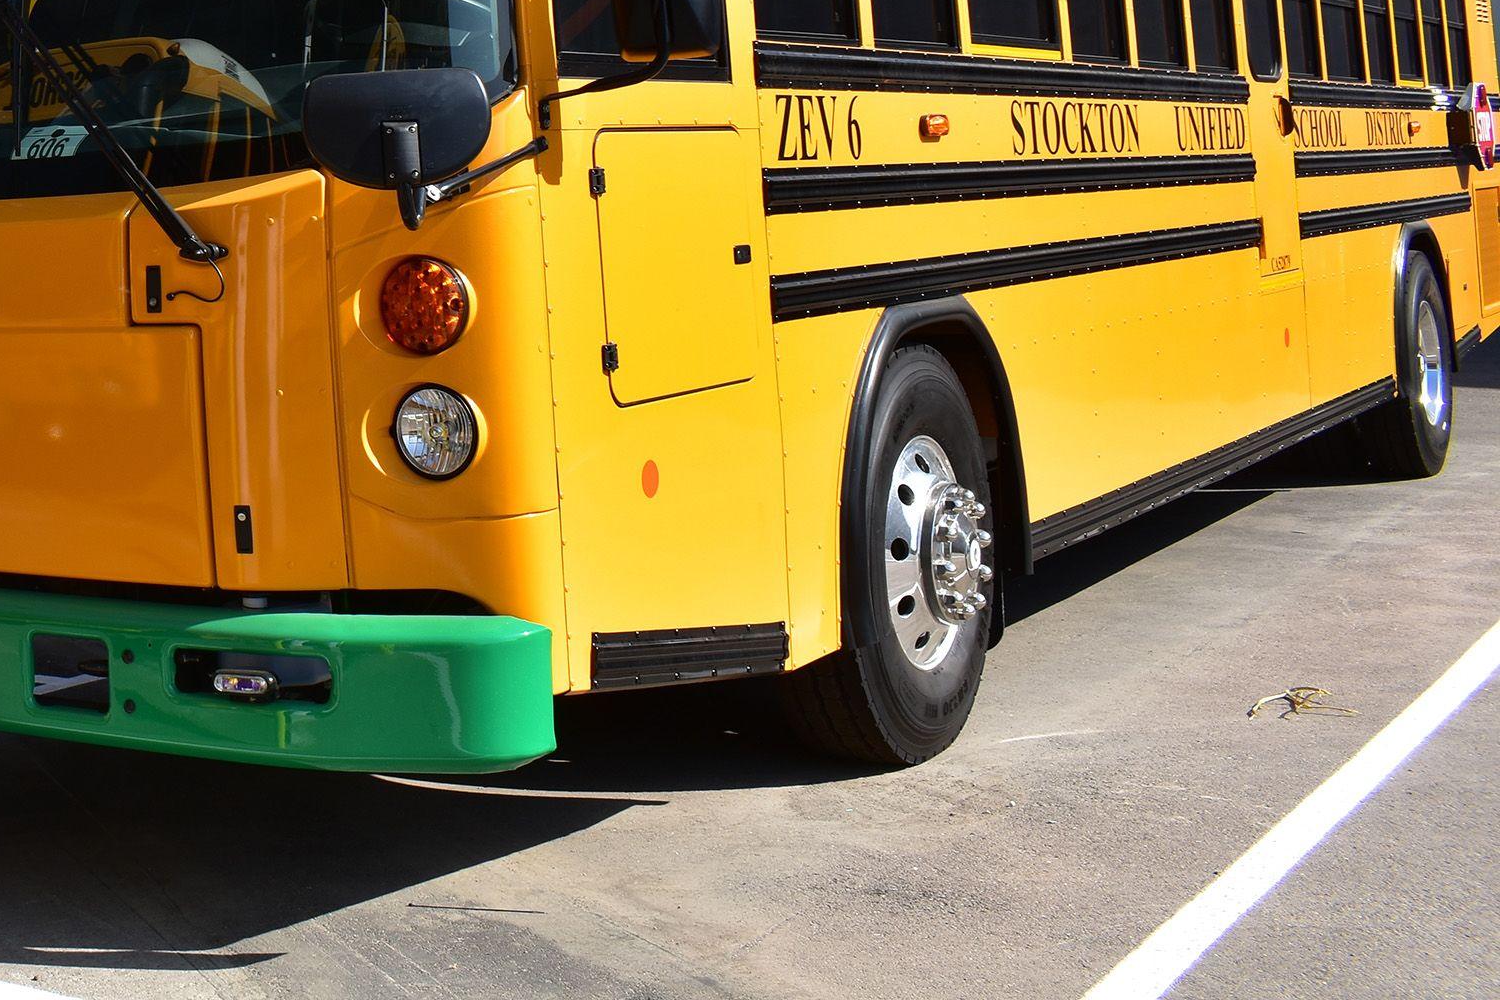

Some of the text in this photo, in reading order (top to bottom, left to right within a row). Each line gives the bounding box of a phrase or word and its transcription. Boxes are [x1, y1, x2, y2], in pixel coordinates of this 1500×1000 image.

[775, 94, 862, 161] ZEV 6
[1011, 100, 1413, 155] STOCKTON UNIFIED SCHOOL DISTRICT
